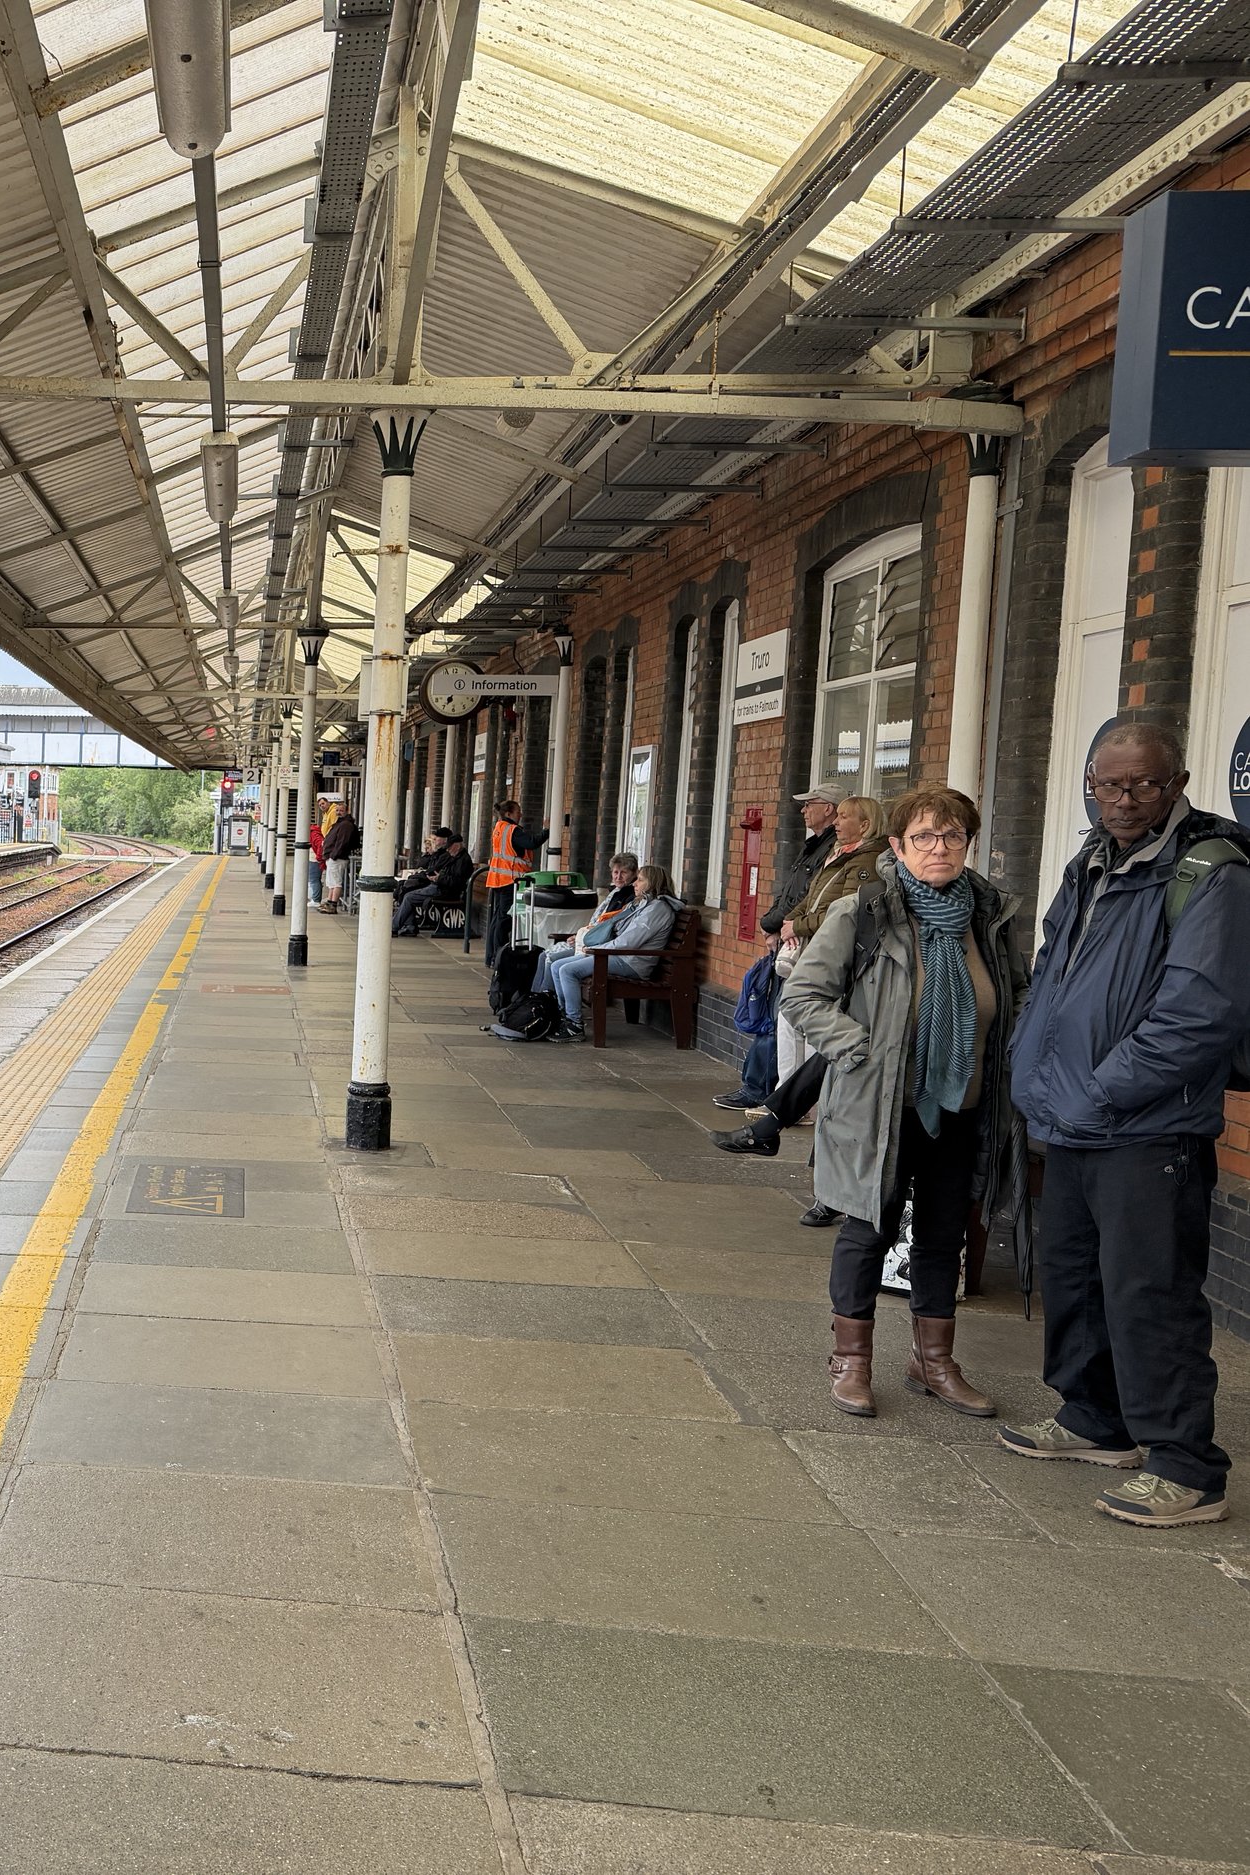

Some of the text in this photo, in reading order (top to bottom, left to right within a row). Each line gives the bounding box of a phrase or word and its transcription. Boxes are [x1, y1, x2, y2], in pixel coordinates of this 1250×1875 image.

[751, 651, 770, 671] Truro
[471, 680, 537, 690] Information
[743, 703, 754, 716] trains
[754, 703, 758, 714] to
[759, 698, 779, 714] Falmouth
[246, 770, 255, 781] 2
[442, 908, 466, 929] GWR
